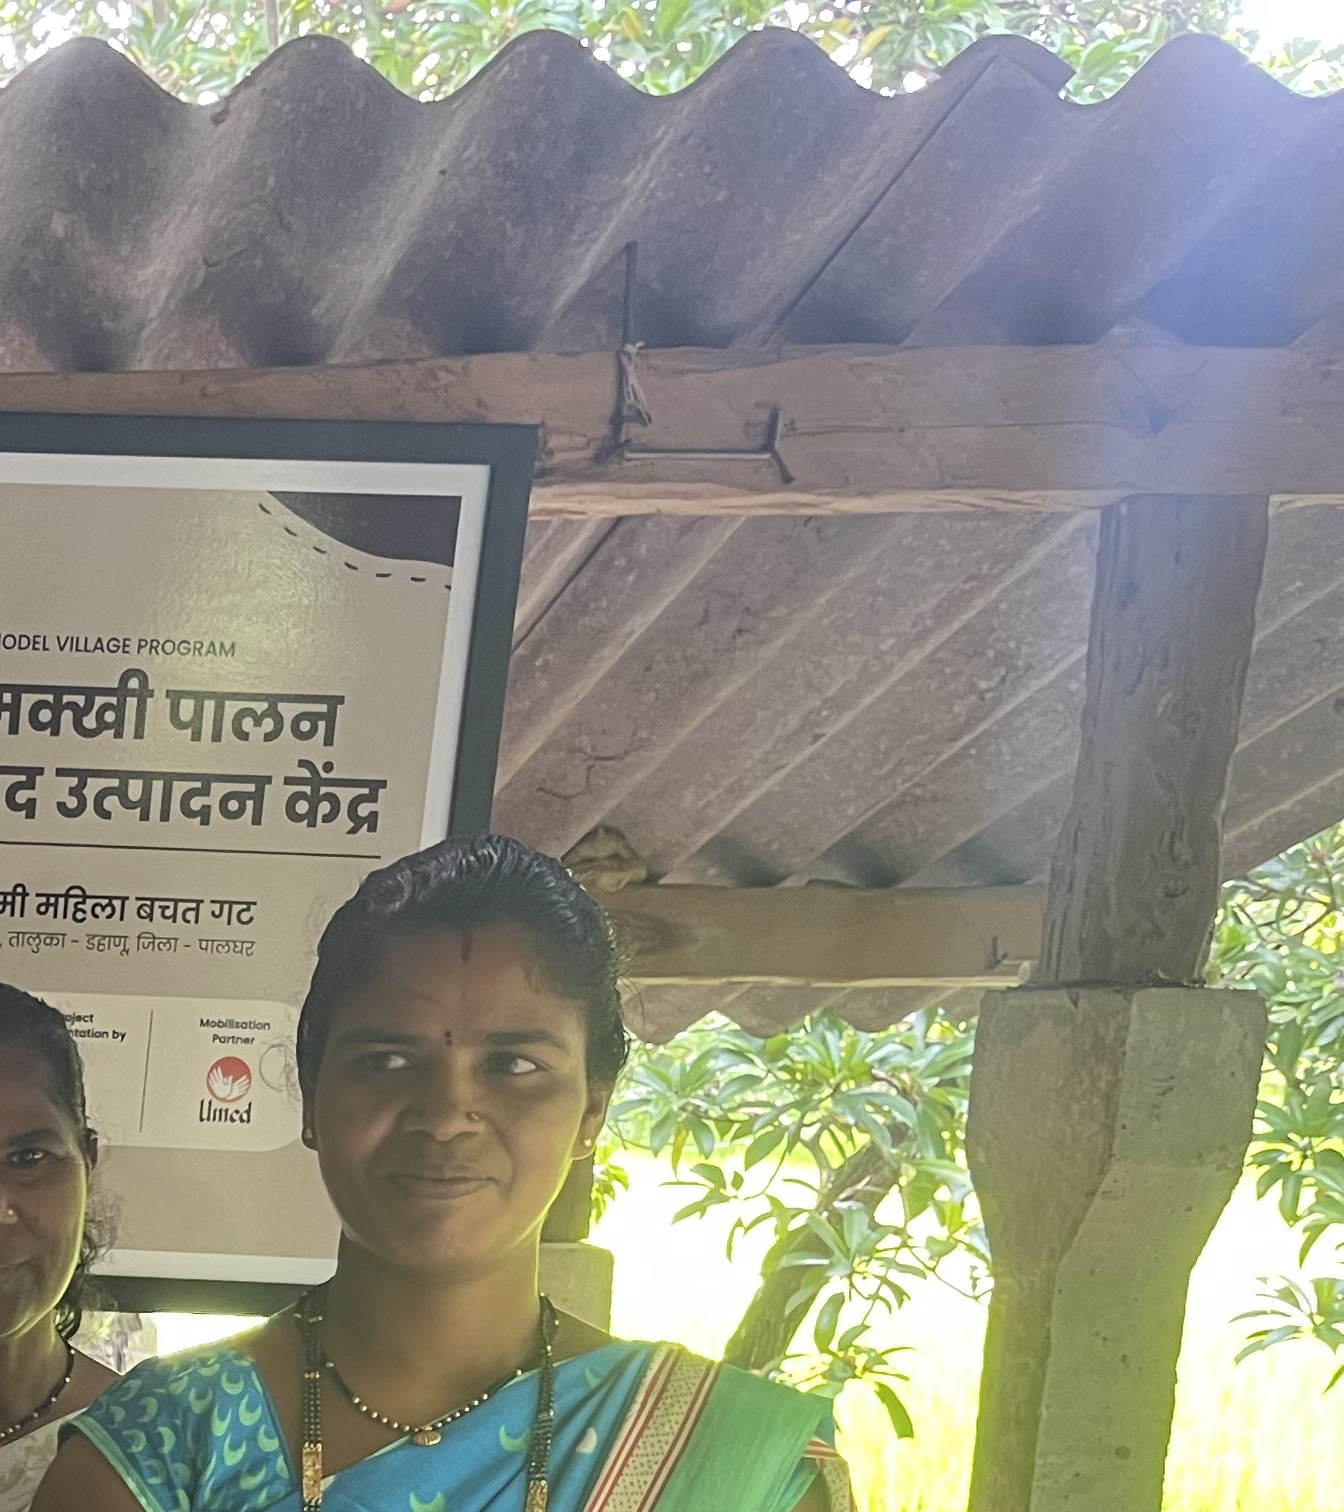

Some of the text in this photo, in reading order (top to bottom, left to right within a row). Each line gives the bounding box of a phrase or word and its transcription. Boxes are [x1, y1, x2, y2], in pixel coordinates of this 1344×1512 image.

[56, 635, 131, 655] VILLAGE
[136, 638, 236, 658] PROGRAM
[166, 689, 345, 747] पालन
[55, 767, 273, 827] उत्पादन
[283, 759, 388, 835] केंद्र
[35, 885, 130, 923] महिला
[135, 896, 204, 924] बचत
[210, 899, 257, 925] गट
[8, 931, 67, 953] तालुका
[136, 931, 179, 953] जिला
[199, 938, 256, 957] पालघर
[64, 1012, 94, 1025] oject
[199, 1018, 271, 1030] Mobilisation
[112, 1029, 127, 1042] by
[212, 1033, 255, 1045] Partner
[199, 1098, 252, 1124] Umed
